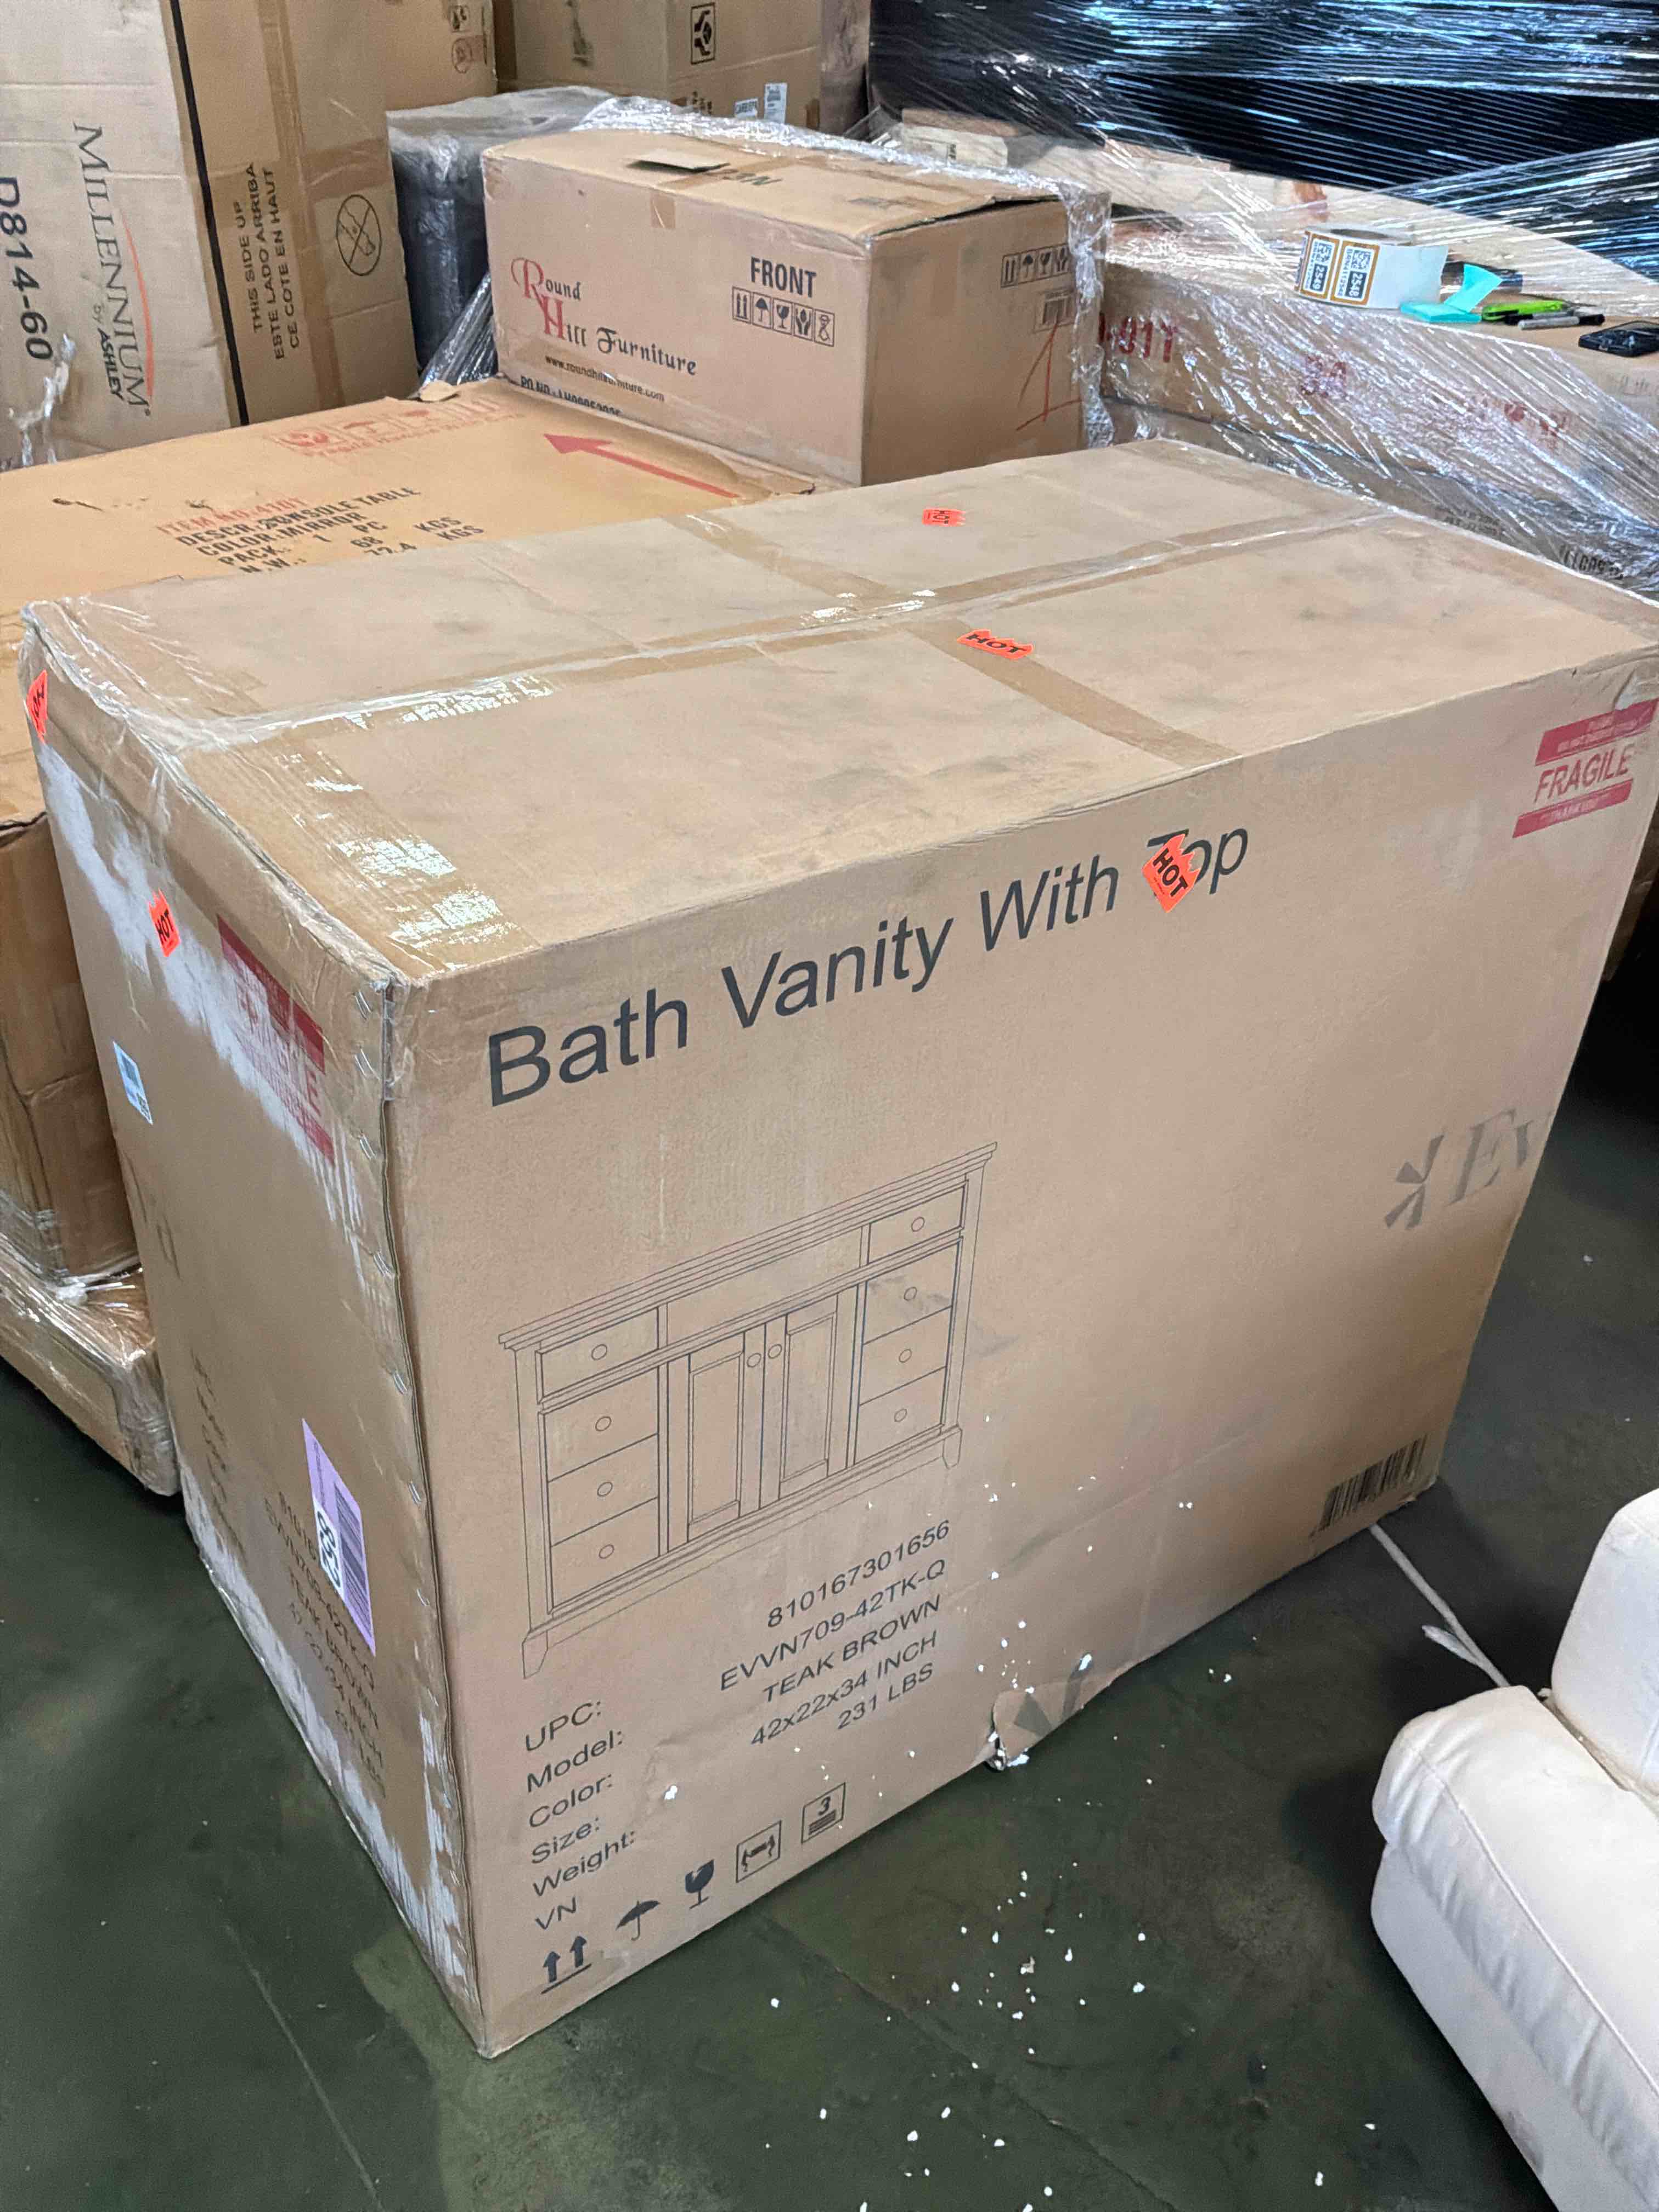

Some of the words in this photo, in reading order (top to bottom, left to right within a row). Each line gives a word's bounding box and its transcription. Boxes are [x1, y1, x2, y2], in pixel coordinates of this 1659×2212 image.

[233, 201, 246, 229] UP
[246, 162, 266, 242] ARRIBA
[262, 167, 280, 224] HAUT
[73, 122, 148, 409] MILLENNIUM
[240, 236, 255, 283] SIDE
[274, 230, 285, 257] EN
[0, 177, 53, 360] D814-60
[259, 248, 276, 304] LADO
[279, 263, 295, 317] COTE
[751, 256, 817, 298] FRONT
[248, 288, 263, 333] THIS
[287, 321, 300, 348] CE
[596, 327, 697, 375] Furniture
[353, 487, 421, 505] TABLE
[353, 521, 388, 533] PC
[413, 516, 461, 532] KGS
[436, 525, 484, 541] KGS
[967, 634, 1028, 653] HOT
[1534, 743, 1635, 803] FRAGILE
[1153, 848, 1188, 897] HOT
[157, 909, 174, 944] HOT
[489, 988, 687, 1107] Bath
[721, 916, 954, 1029] Vanity
[980, 854, 1119, 952] With
[526, 1701, 602, 1753] UPC:
[768, 1520, 950, 1628] 810167301656
[527, 1730, 623, 1793] Model:
[720, 1559, 946, 1691] EVVN709-42TK-Q
[529, 1773, 612, 1828] Color:
[763, 1656, 834, 1704] TEAK
[842, 1594, 941, 1662] BROWN
[532, 1817, 600, 1865] Size:
[751, 1672, 867, 1746] 42x22x34
[877, 1630, 937, 1677] INCH
[533, 1830, 635, 1898] Weight:
[838, 1694, 879, 1730] 231
[887, 1662, 934, 1703] LBS
[535, 1897, 578, 1931] VN
